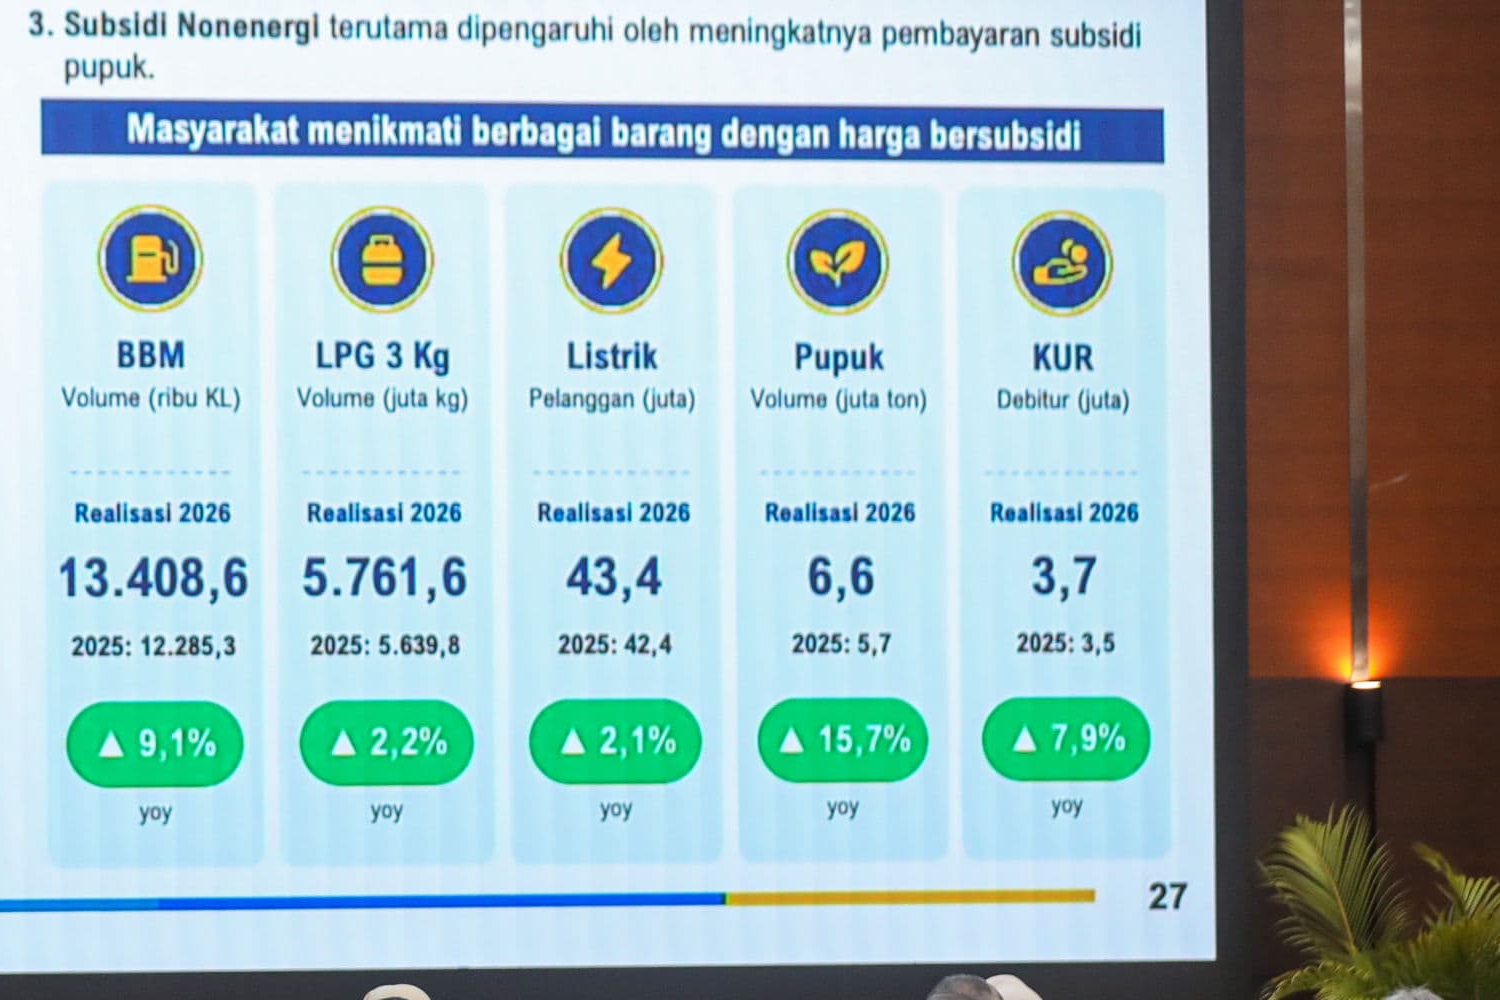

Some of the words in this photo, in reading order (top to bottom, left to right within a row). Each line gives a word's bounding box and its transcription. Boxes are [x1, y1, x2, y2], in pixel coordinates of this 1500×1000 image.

[29, 10, 53, 36] 3.
[65, 11, 166, 37] Subsidi
[178, 12, 318, 45] Nonenergi
[330, 15, 447, 40] terutama
[458, 15, 613, 48] dipengaruhi
[624, 16, 678, 42] oleh
[690, 18, 871, 52] meningkatnya
[883, 20, 1039, 53] pembayaran
[1051, 22, 1141, 48] subsidi
[65, 53, 154, 85] pupuk.
[128, 112, 299, 151] Masyarakat
[308, 114, 461, 145] menikmati
[473, 115, 600, 154] berbagai
[612, 116, 711, 155] barang
[721, 117, 829, 155] dengan
[839, 118, 920, 156] harga
[930, 119, 1081, 150] bersubsidi
[118, 341, 184, 368] BBM
[317, 341, 374, 369] LPG
[387, 341, 402, 369] 3
[415, 341, 449, 376] Kg
[568, 342, 657, 369] Listrik
[796, 343, 884, 377] Pupuk
[1034, 344, 1093, 371] KUR
[62, 387, 140, 408] Volume
[149, 387, 197, 412] (ribu
[206, 387, 240, 413] KL)
[297, 387, 374, 408] Volume
[384, 387, 428, 413] (juta
[436, 388, 468, 413] kg)
[530, 387, 634, 413] Pelanggan
[643, 388, 695, 413] (juta)
[751, 388, 827, 408] Volume
[836, 389, 879, 414] (juta
[887, 389, 926, 414] ton)
[998, 389, 1069, 409] Debitur
[1078, 389, 1129, 415] (juta)
[76, 502, 171, 523] Realisasi
[180, 502, 231, 523] 2026
[308, 502, 403, 522] Realisasi
[411, 502, 461, 522] 2026
[538, 502, 632, 522] Realisasi
[640, 502, 690, 522] 2026
[766, 502, 858, 522] Realisasi
[866, 502, 915, 522] 2026
[991, 502, 1082, 522] Realisasi
[1090, 502, 1139, 522] 2026
[60, 557, 247, 604] 13.408,6
[304, 556, 466, 604] 5.761,6
[567, 556, 662, 603] 43,4
[809, 556, 873, 602] 6,6
[1033, 556, 1096, 602] 3,7
[72, 636, 131, 656] 2025:
[142, 635, 236, 659] 12.285,3
[311, 635, 369, 655] 2025:
[379, 635, 460, 658] 5.639,8
[559, 634, 616, 654] 2025:
[624, 634, 672, 657] 42,4
[793, 633, 849, 653] 2025:
[858, 633, 891, 656] 5,7
[1017, 632, 1074, 653] 2025:
[1082, 632, 1115, 656] 3,5
[140, 728, 218, 761] 9,1%
[371, 727, 449, 760] 2,2%
[601, 726, 676, 759] 2,1%
[820, 724, 912, 757] 15,7%
[1052, 723, 1128, 755] 7,9%
[140, 806, 172, 826] yoy
[371, 804, 403, 823] yoy
[600, 803, 632, 822] yoy
[828, 801, 859, 820] yoy
[1052, 800, 1083, 819] yoy
[1150, 882, 1187, 909] 27
